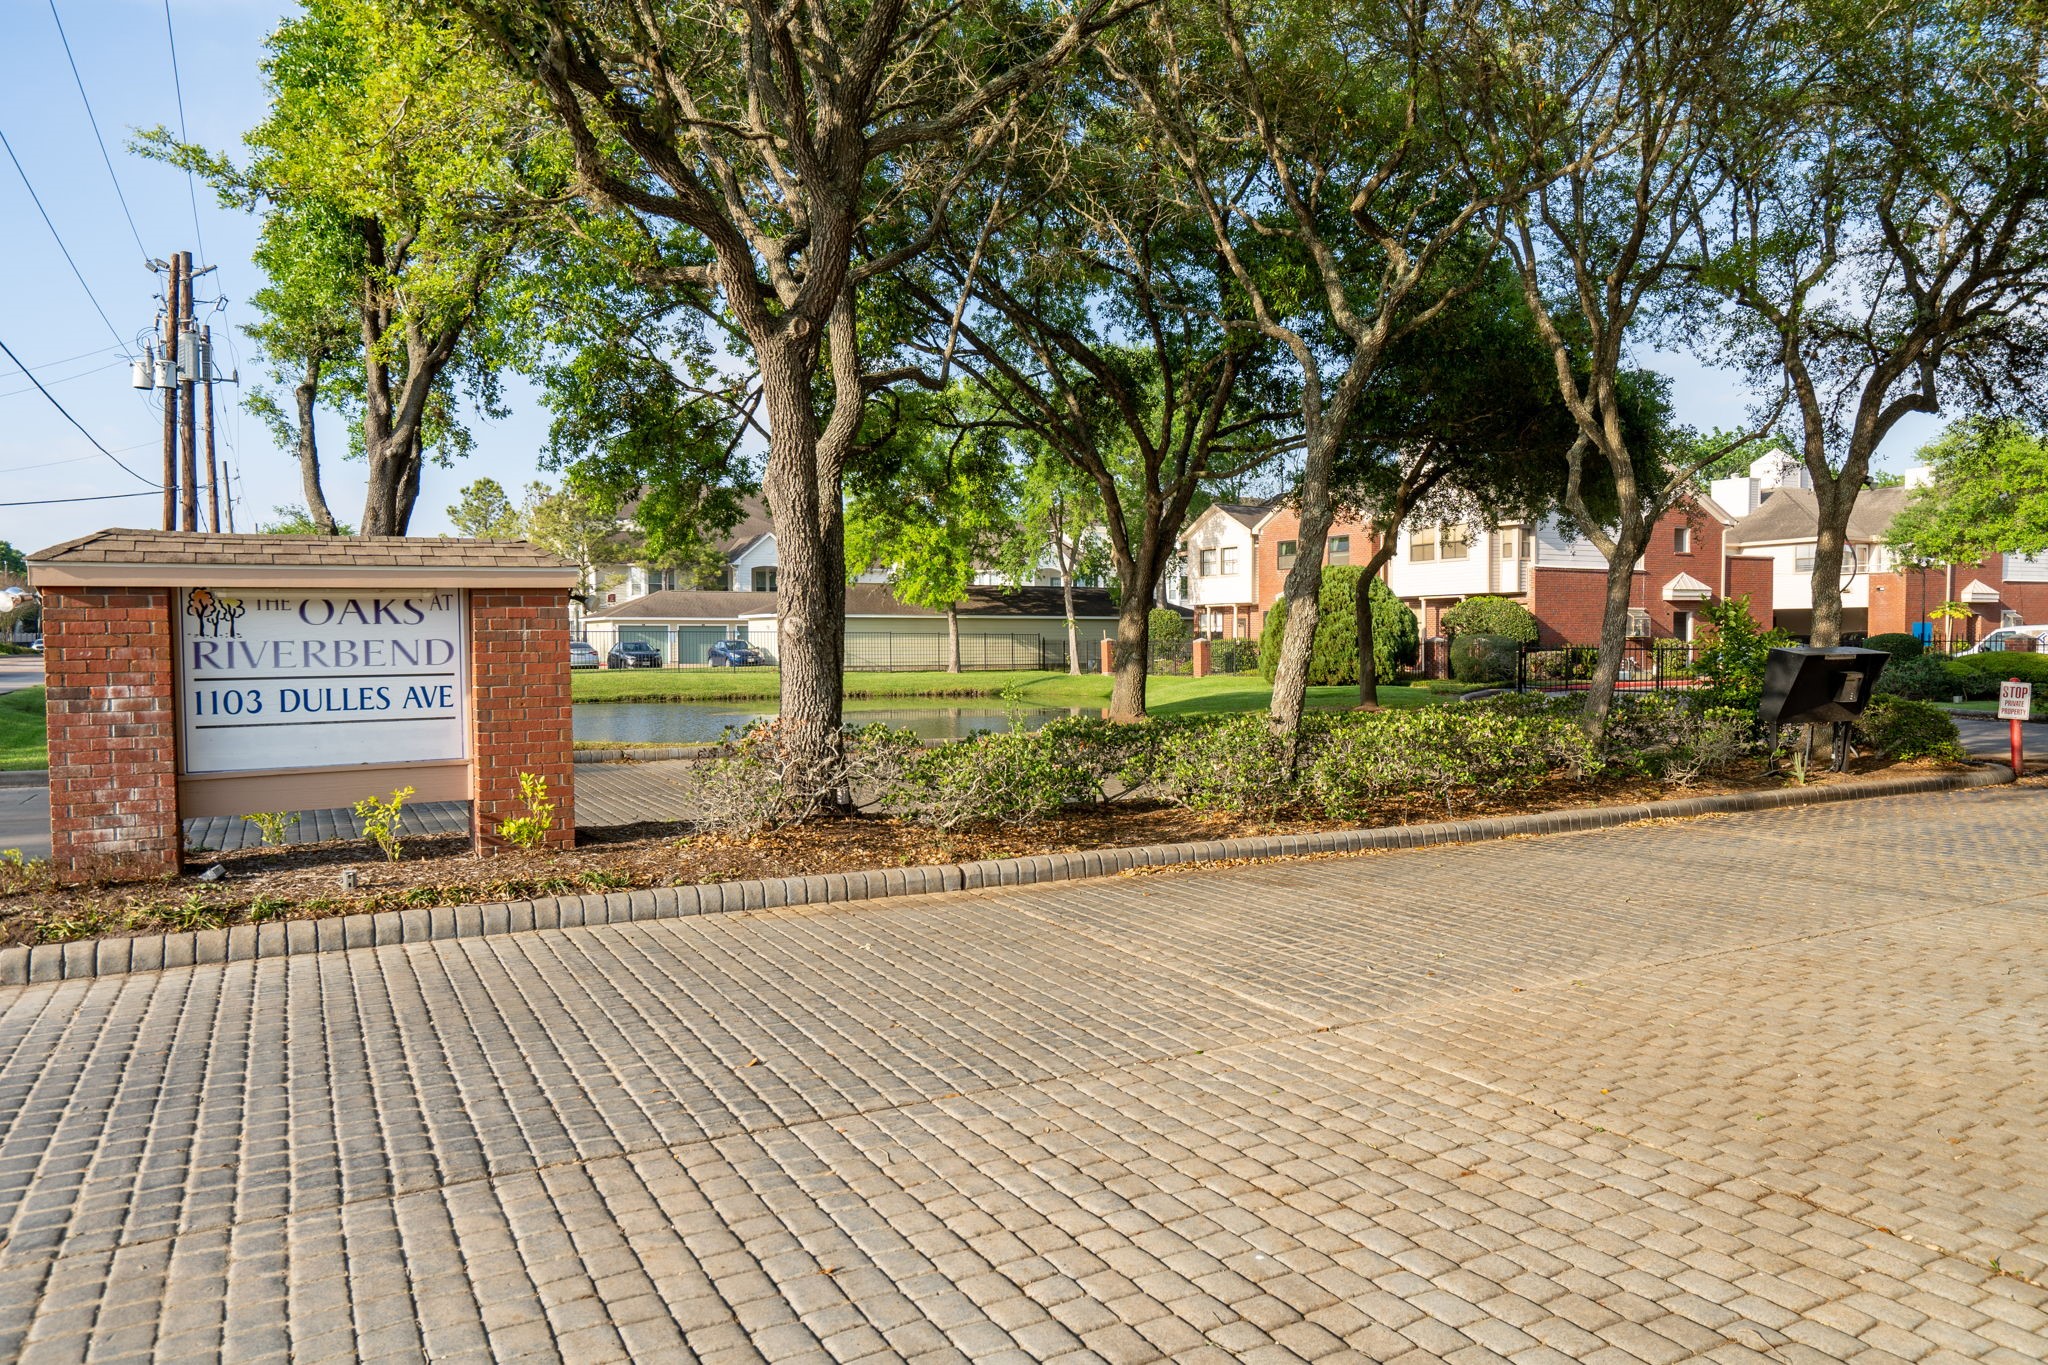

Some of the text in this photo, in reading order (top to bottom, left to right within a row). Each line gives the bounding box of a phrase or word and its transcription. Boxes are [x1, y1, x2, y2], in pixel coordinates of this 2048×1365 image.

[299, 598, 426, 626] OAKS
[429, 594, 454, 612] AT
[192, 638, 455, 670] RIVERBEND
[195, 685, 454, 716] 1103 DULLES AVE
[2003, 686, 2028, 699] STOP
